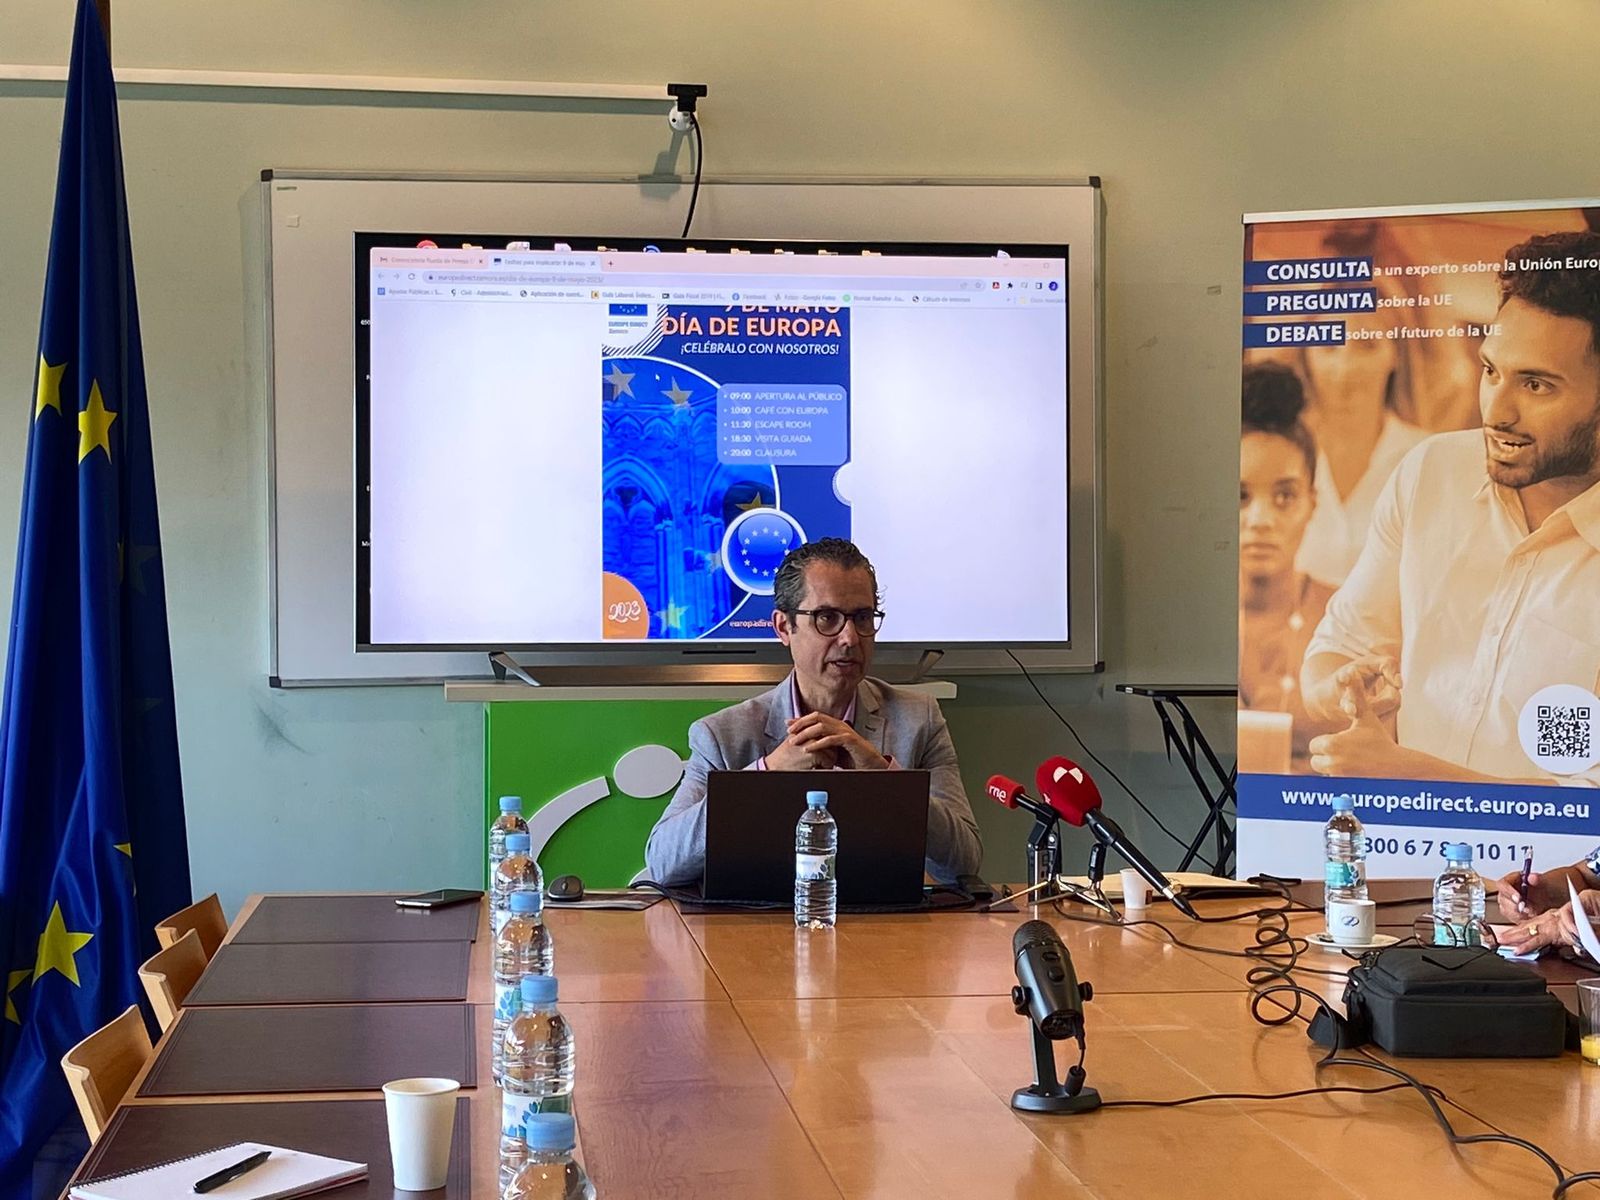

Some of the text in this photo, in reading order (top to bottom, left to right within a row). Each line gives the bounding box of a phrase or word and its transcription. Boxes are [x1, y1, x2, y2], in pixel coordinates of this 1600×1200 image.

[1266, 256, 1600, 281] CONSULTA a un experto sobre la Unión Euro
[1266, 292, 1453, 311] PREGUNTA sobre la UE
[662, 312, 842, 337] DÍA DE EUROPA
[1266, 323, 1502, 343] DEBATE sobre el futuro de la UE
[680, 340, 839, 355] ¡CELÉBRALO CON NOSOTROS!
[755, 391, 796, 400] APERTURA
[797, 391, 807, 400] AL
[776, 406, 795, 414] CON
[796, 406, 829, 415] EUROPA
[755, 420, 784, 429] ESCAPE
[785, 420, 812, 429] ROOM
[755, 434, 780, 443] VISITA
[755, 448, 797, 457] CLAUSURA
[1282, 790, 1590, 821] wwwuropedirect.europa.eu
[1404, 839, 1416, 855] 6
[1422, 840, 1434, 856] 7
[1476, 843, 1501, 860] 10
